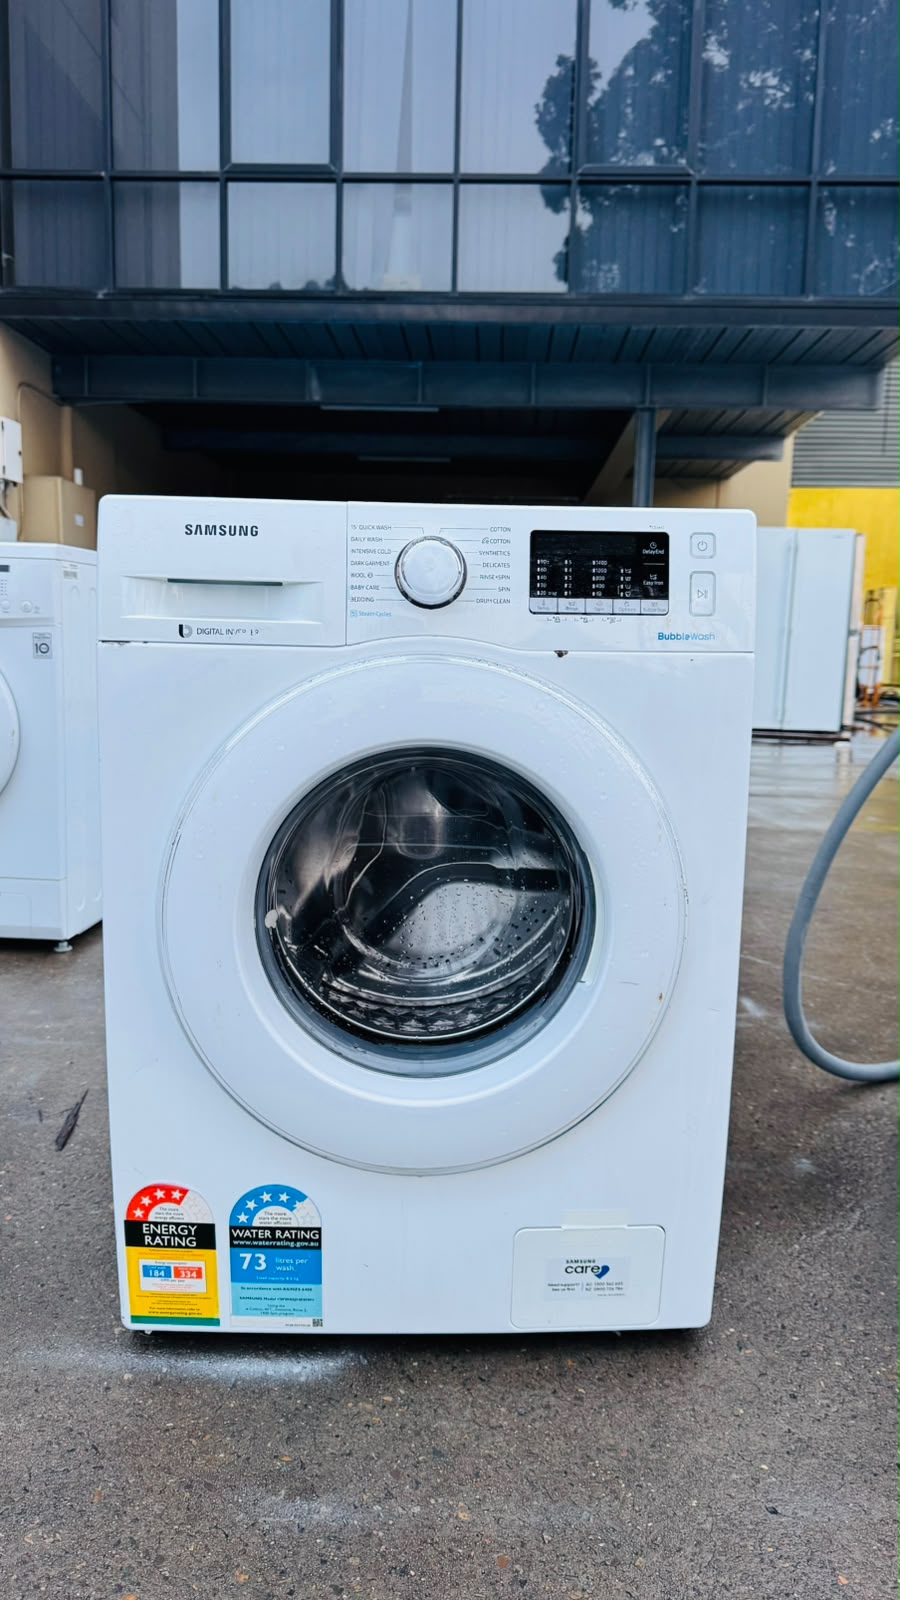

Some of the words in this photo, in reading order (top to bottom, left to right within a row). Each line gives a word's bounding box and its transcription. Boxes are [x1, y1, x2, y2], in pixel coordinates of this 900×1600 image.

[184, 523, 259, 537] SAMSUNG
[196, 627, 224, 636] DIGITAL
[657, 631, 715, 641] BubbleWash
[34, 642, 50, 655] 10
[142, 1223, 198, 1236] ENERGY
[231, 1228, 272, 1239] WATER
[275, 1229, 320, 1240] RATING
[144, 1235, 197, 1248] RATING
[233, 1240, 319, 1248] www.waterrating.gov.au
[239, 1253, 267, 1271] 73
[564, 1264, 601, 1274] care
